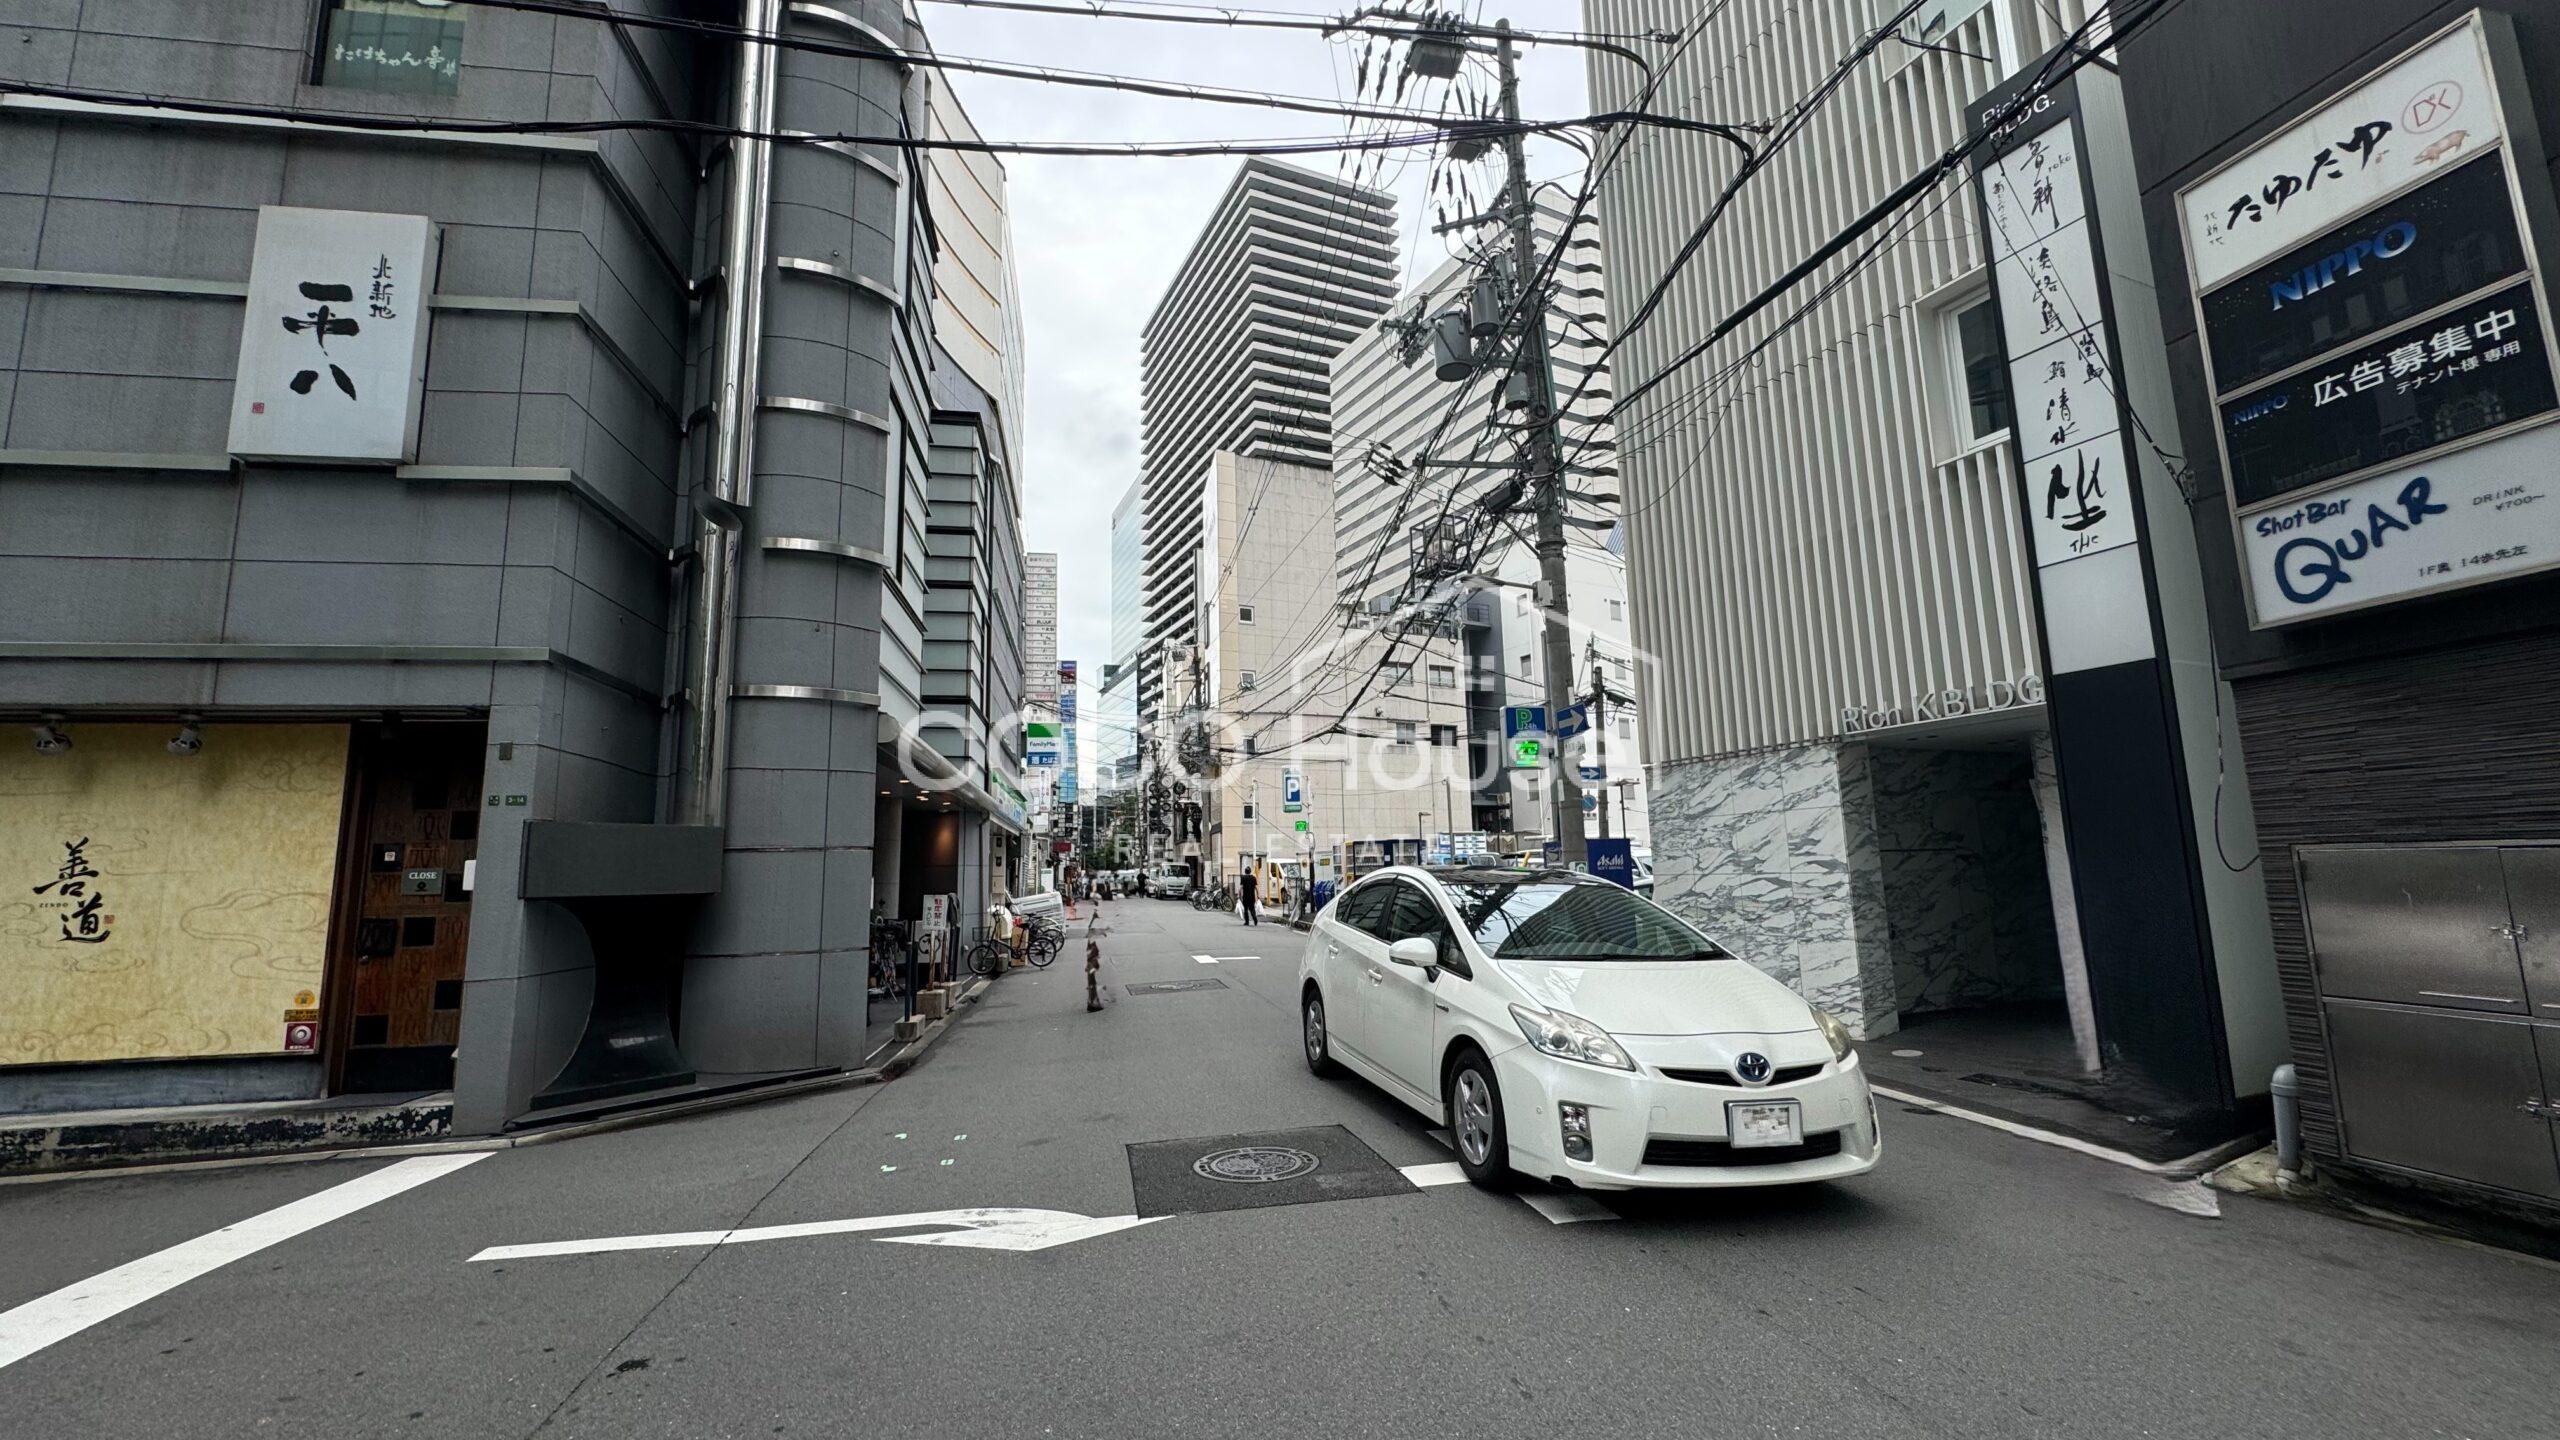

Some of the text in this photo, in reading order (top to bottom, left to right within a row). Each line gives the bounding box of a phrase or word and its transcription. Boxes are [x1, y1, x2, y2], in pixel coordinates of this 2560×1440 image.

[2228, 121, 2392, 230] たゆたゆ
[368, 253, 397, 320] 北新地
[2268, 221, 2417, 311] NIPPO
[2313, 308, 2517, 408] 広告募集中
[2396, 339, 2522, 395] テナント様 専用
[2232, 394, 2289, 426] NIPPO
[2256, 497, 2352, 538] Shot Bar
[2473, 484, 2525, 506] DRINK
[1840, 701, 1902, 733] Rich
[408, 871, 438, 880] CLOSE
[1597, 853, 1624, 866] Asahi
[31, 836, 111, 944] 善道
